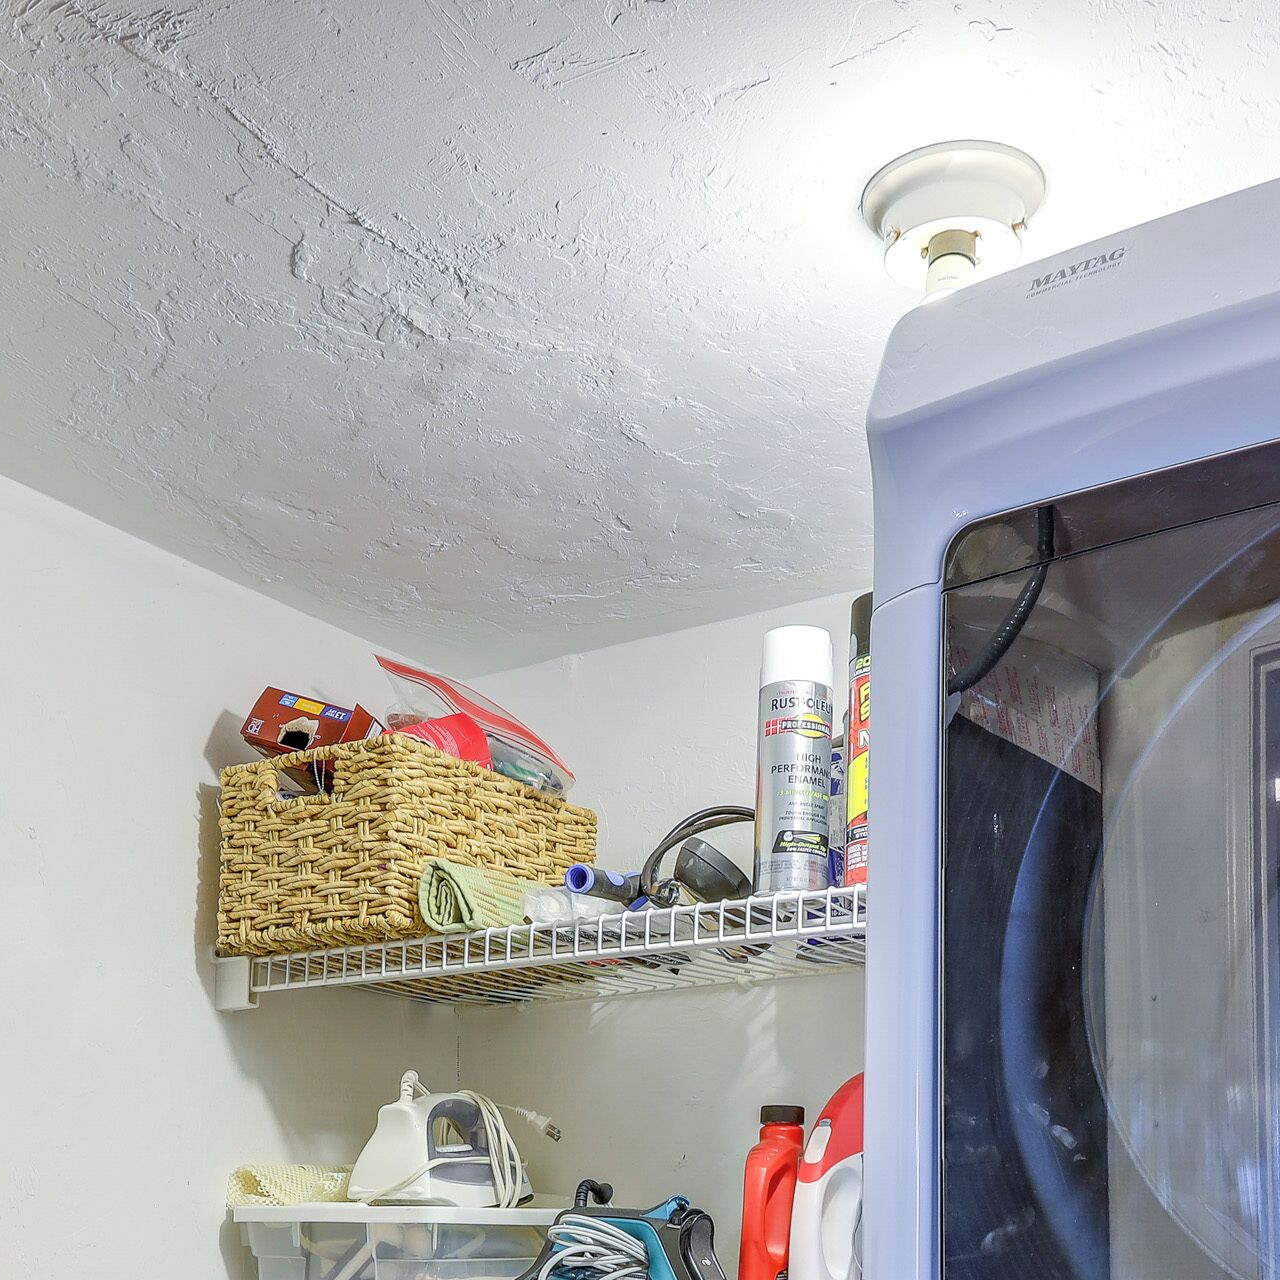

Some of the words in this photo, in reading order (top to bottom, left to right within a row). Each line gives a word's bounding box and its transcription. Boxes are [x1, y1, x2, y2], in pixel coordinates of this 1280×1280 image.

[1028, 248, 1125, 292] MAYTAG
[1026, 280, 1072, 299] COMMERCIAL
[781, 721, 830, 735] PROFESSIONAL
[788, 775, 825, 788] ENAMEL
